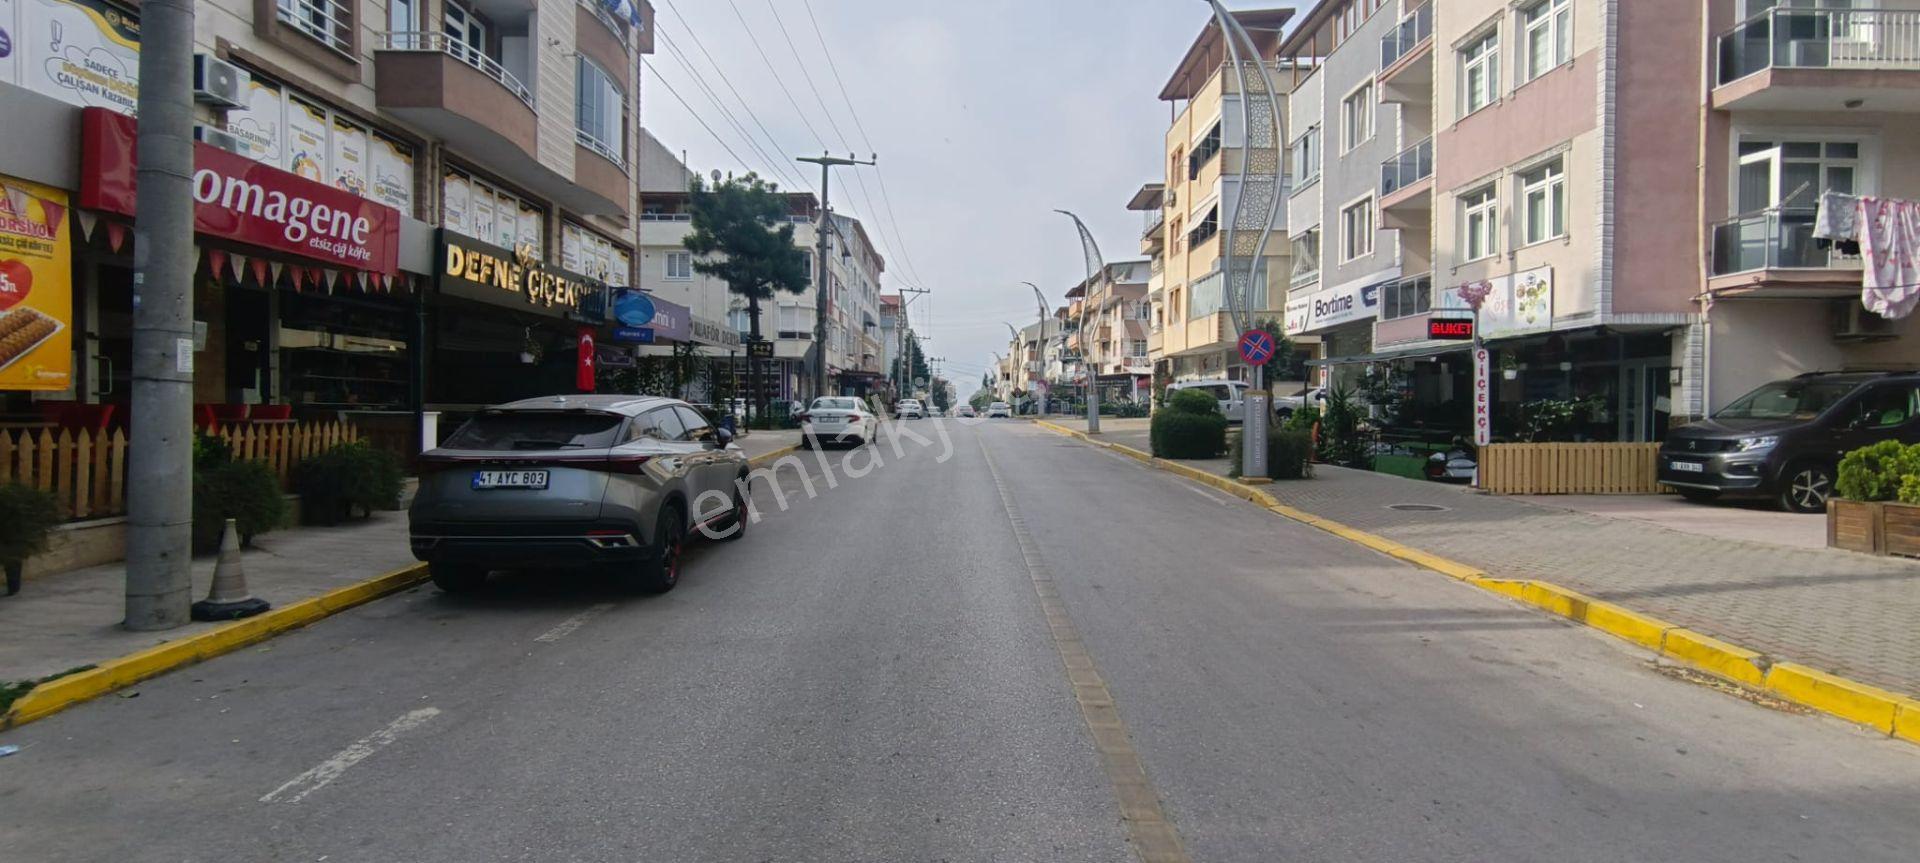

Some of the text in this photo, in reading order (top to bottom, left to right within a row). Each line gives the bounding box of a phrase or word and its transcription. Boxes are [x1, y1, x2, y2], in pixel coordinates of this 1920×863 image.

[83, 58, 119, 79] SADECE
[310, 237, 332, 252] etsiz
[348, 244, 371, 261] köfte
[446, 243, 521, 292] DEFNE
[1315, 294, 1353, 318] Bortime
[1431, 321, 1473, 334] BUKET
[1477, 350, 1487, 444] ÇİÇEKÇİ
[479, 472, 544, 485] 41 AYC 803
